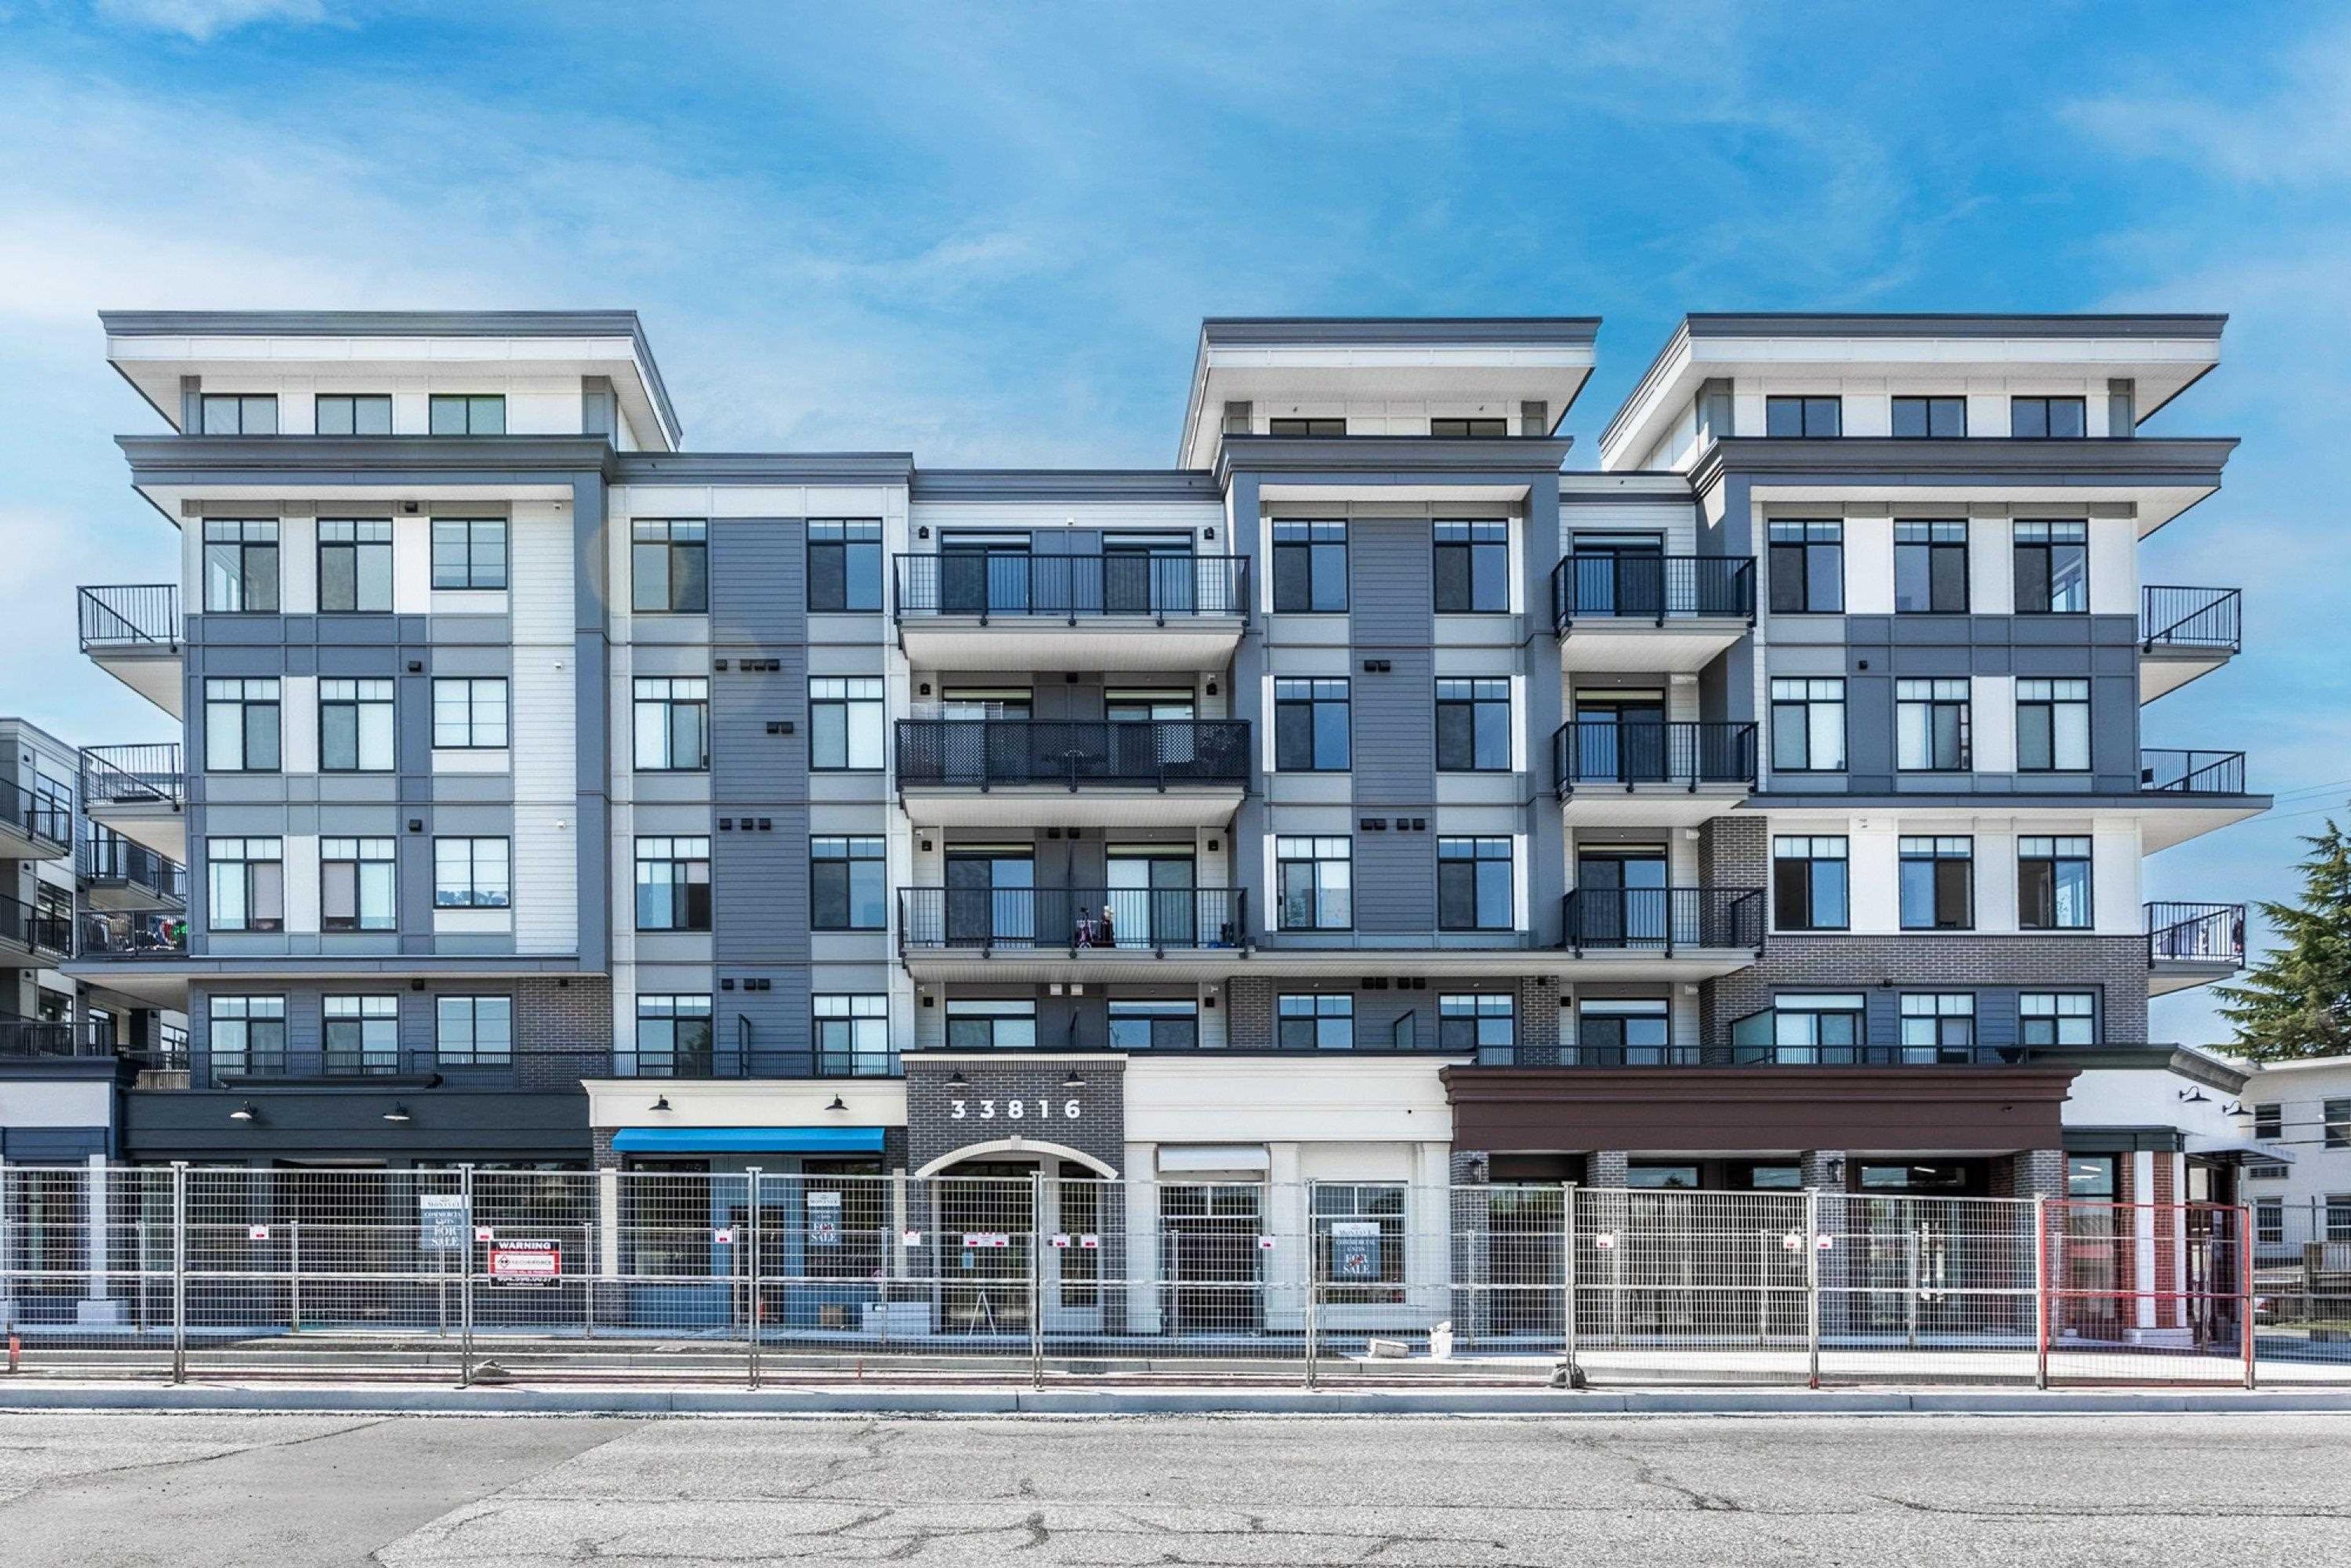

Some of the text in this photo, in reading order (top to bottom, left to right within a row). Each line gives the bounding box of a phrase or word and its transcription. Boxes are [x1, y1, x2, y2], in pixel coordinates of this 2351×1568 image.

[951, 1100, 1080, 1119] 33816
[434, 1226, 457, 1236] FOR
[431, 1237, 459, 1247] SALE
[1343, 1265, 1371, 1274] SALE
